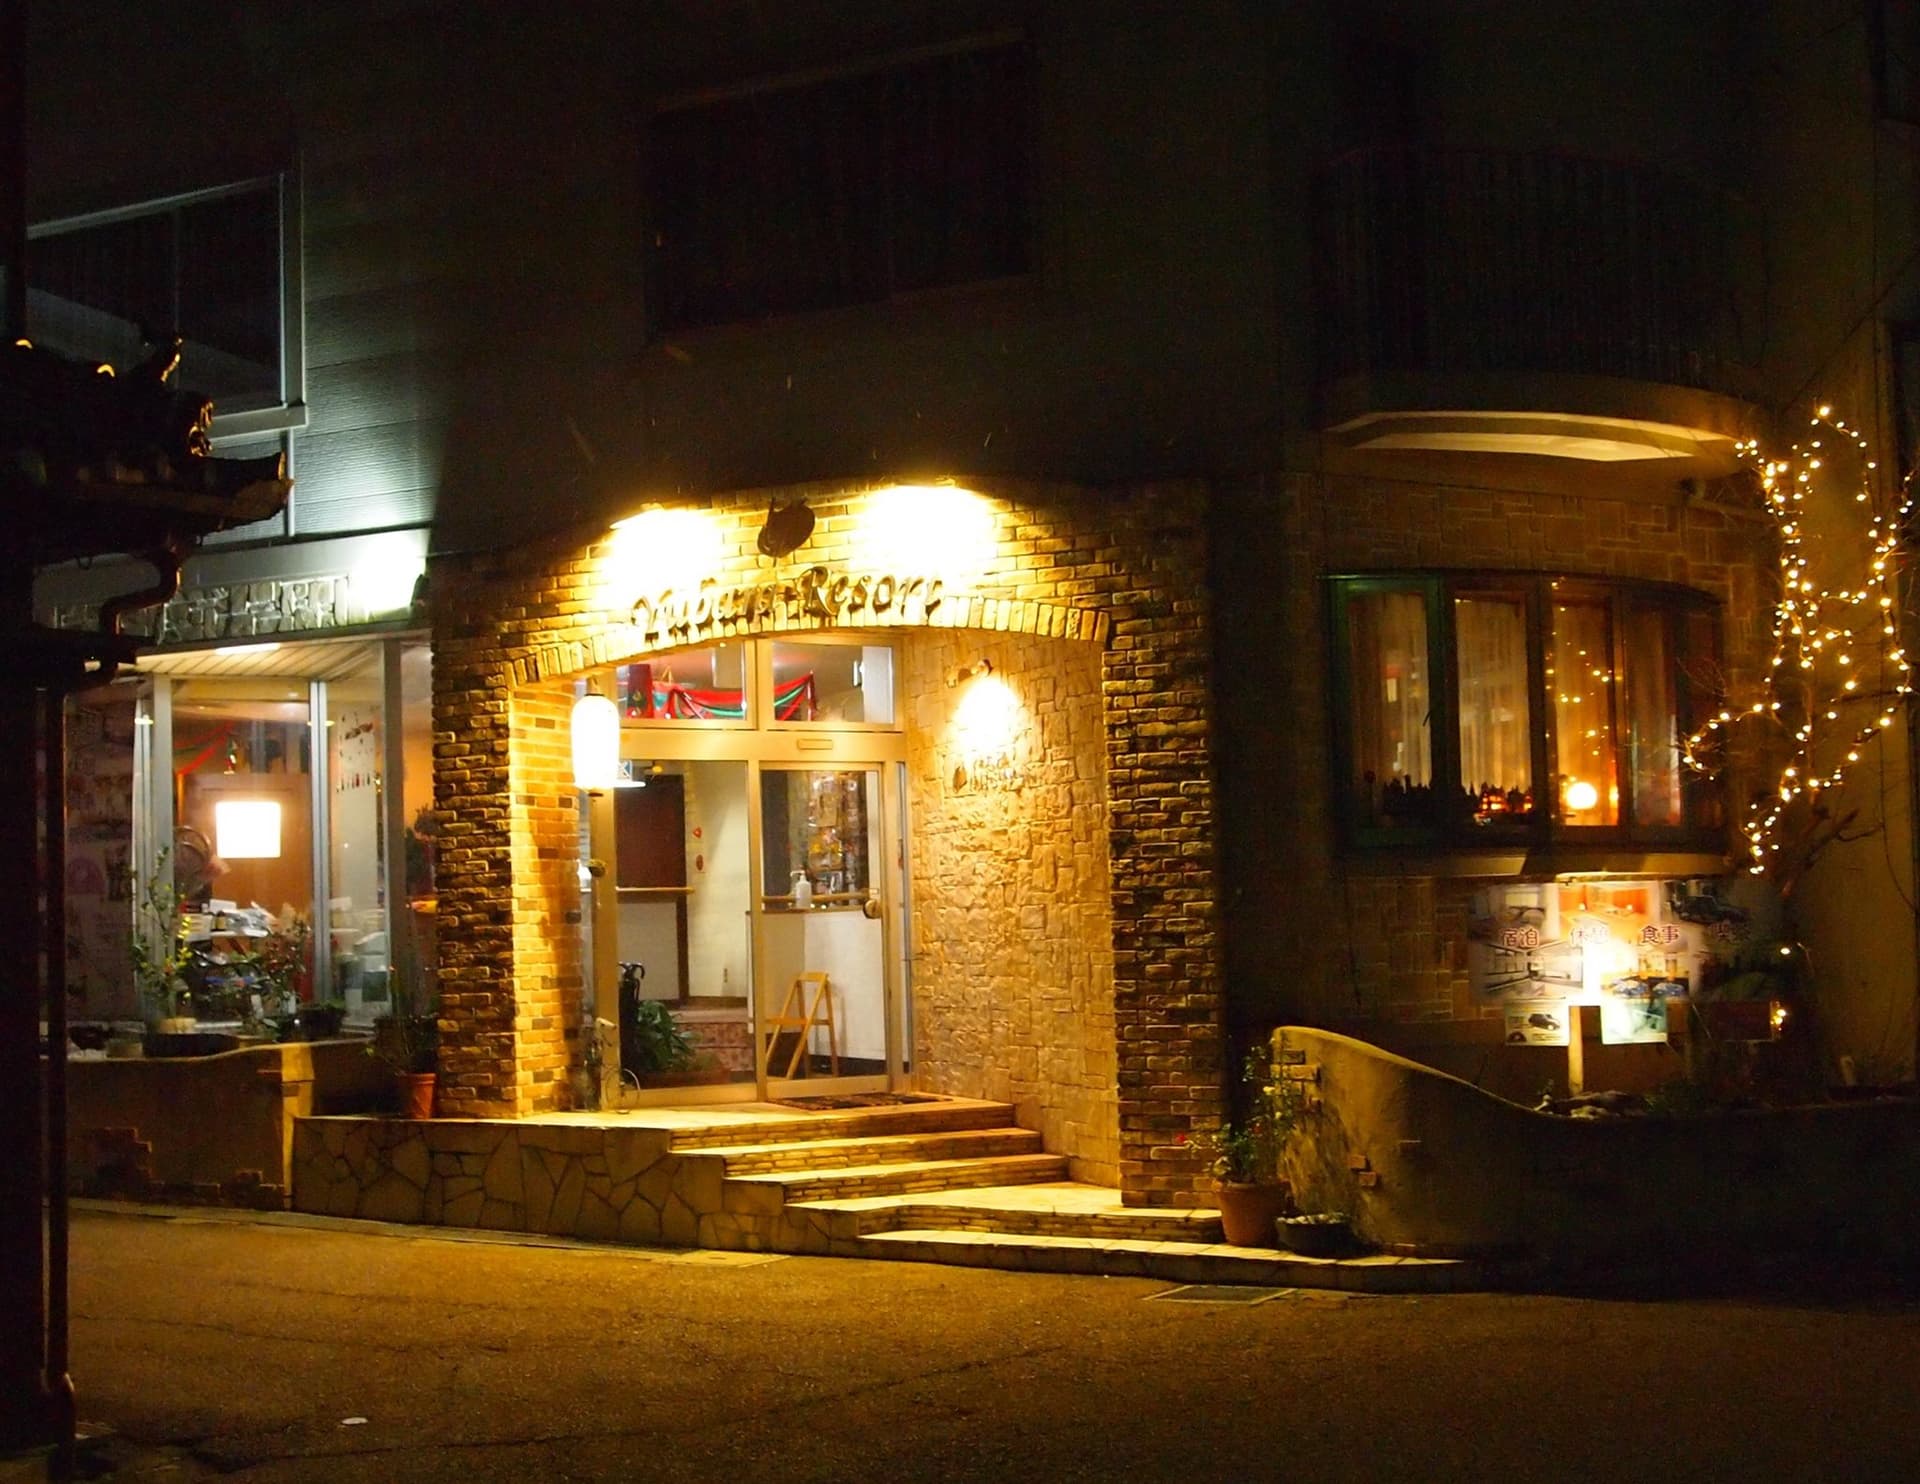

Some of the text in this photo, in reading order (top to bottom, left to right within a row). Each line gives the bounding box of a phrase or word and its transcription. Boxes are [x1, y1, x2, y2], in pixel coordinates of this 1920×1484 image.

[795, 566, 944, 617] Resort
[1502, 927, 1539, 948] 宿泊
[1639, 924, 1680, 944] 食事
